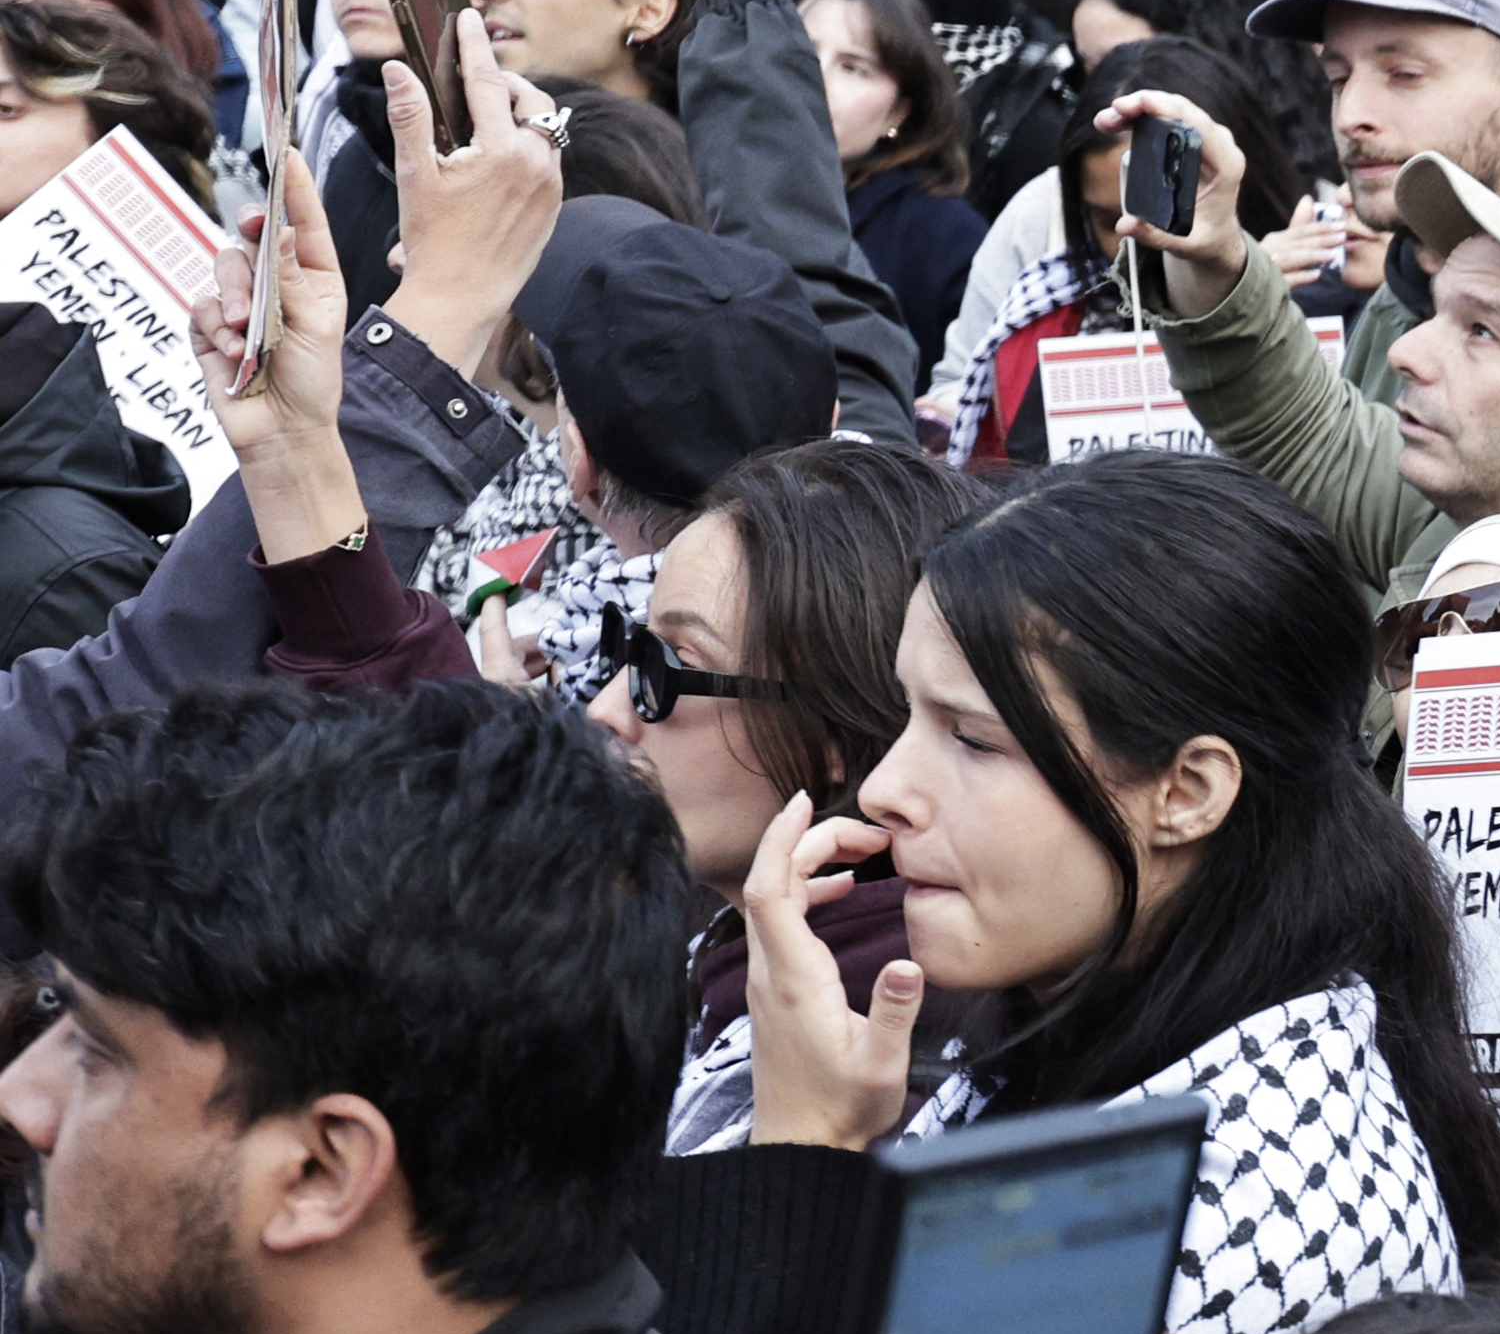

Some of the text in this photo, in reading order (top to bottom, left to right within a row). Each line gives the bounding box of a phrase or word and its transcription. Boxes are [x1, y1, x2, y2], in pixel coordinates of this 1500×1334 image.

[20, 250, 213, 450] YEMEN LIBAN
[33, 209, 184, 357] PALESTINE
